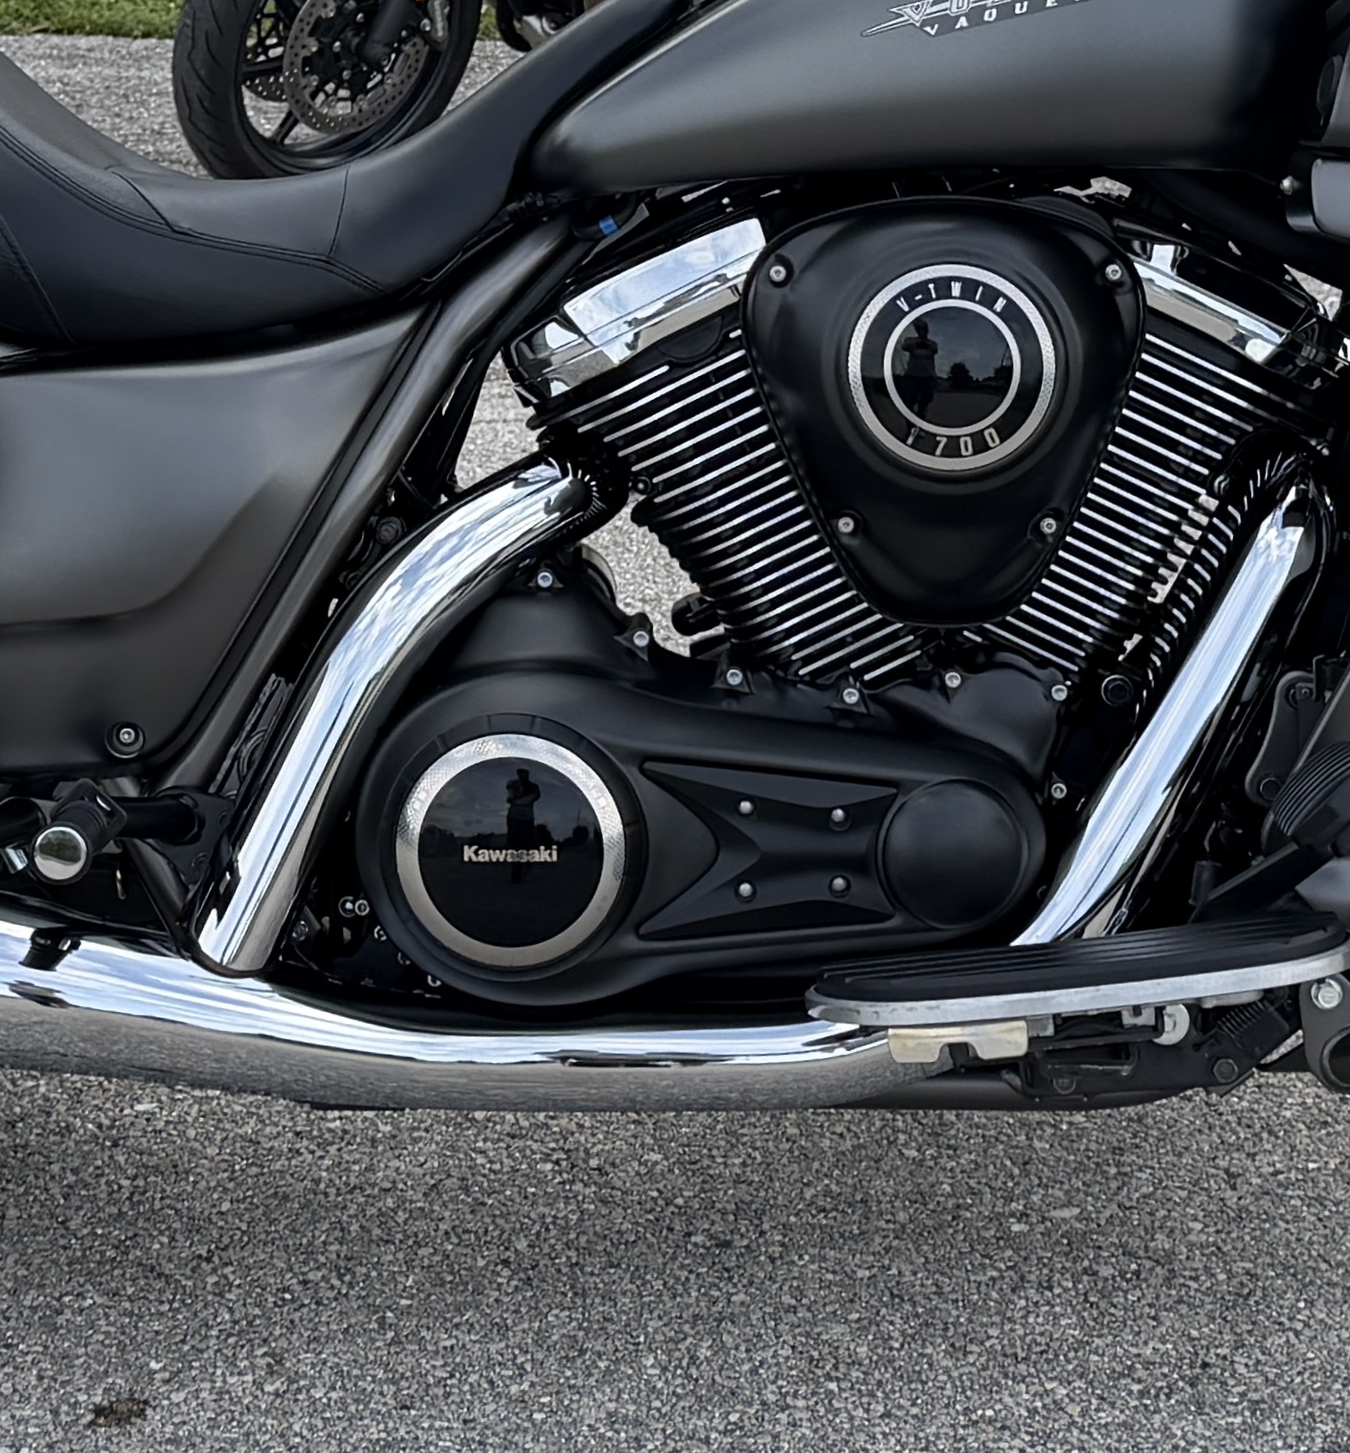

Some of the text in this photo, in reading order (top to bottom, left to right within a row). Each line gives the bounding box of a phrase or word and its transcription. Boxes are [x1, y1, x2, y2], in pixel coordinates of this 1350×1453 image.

[896, 281, 1007, 313] V-TWIN
[905, 426, 1001, 457] 1700
[462, 844, 558, 863] Kawasaki
